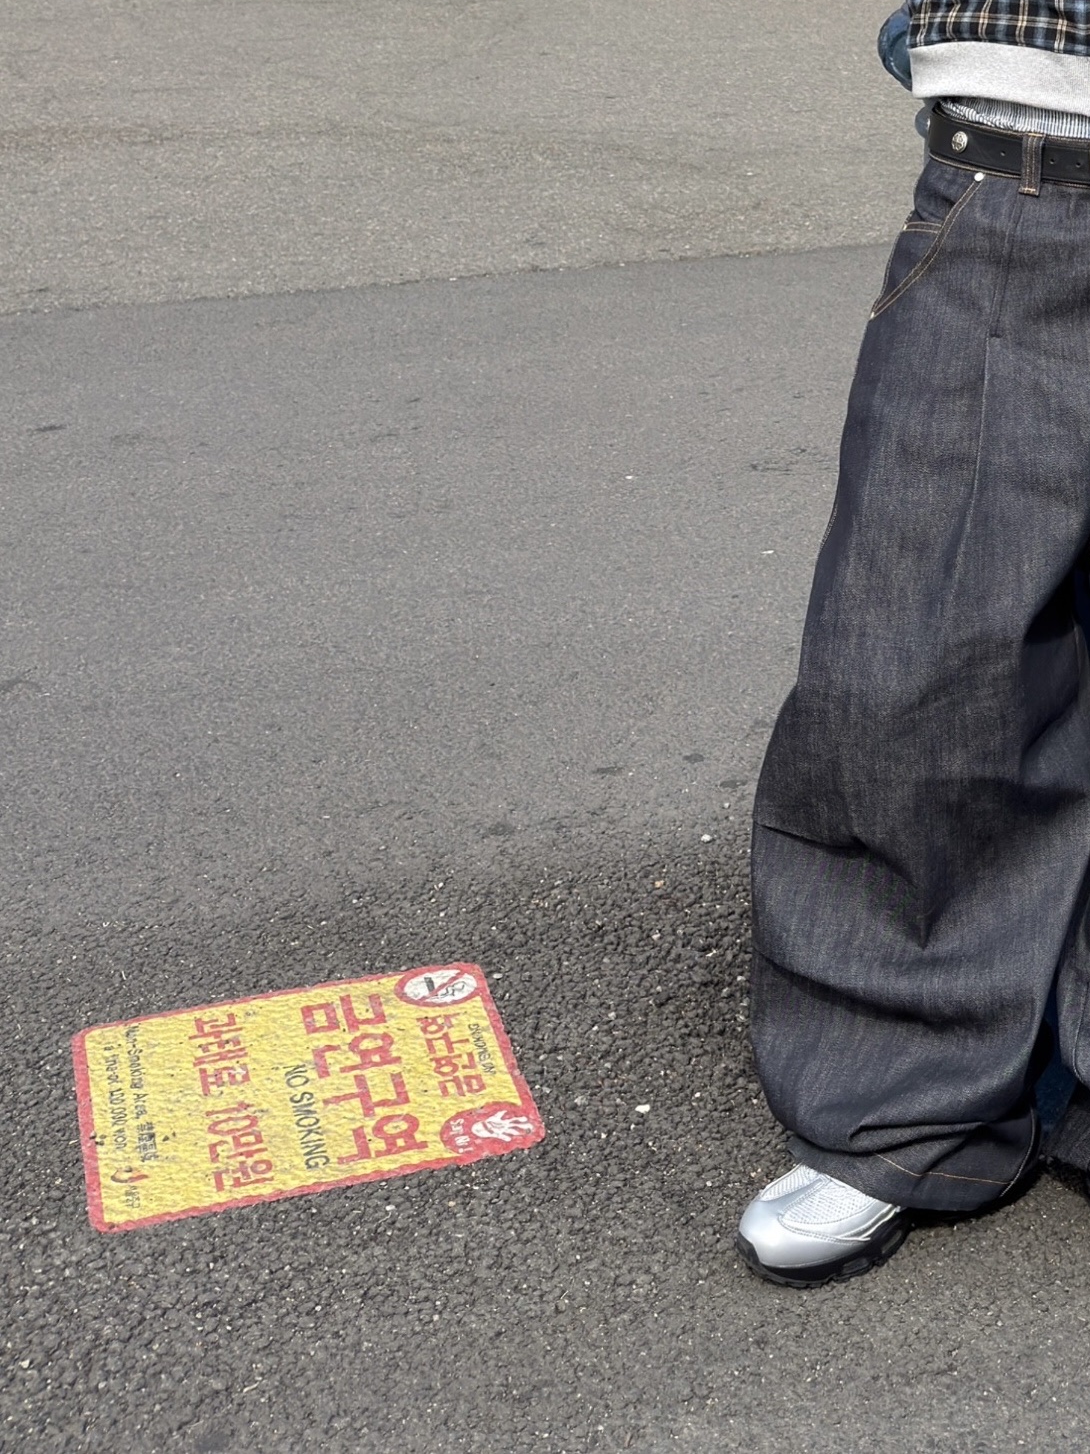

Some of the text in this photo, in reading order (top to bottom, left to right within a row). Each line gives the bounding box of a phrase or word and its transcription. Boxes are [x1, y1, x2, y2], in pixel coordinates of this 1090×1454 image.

[189, 1012, 275, 1192] 과태료 10만원
[282, 1064, 331, 1170] NO SMOKING
[300, 993, 429, 1165] 금연구역
[416, 1012, 486, 1098] 금연구역
